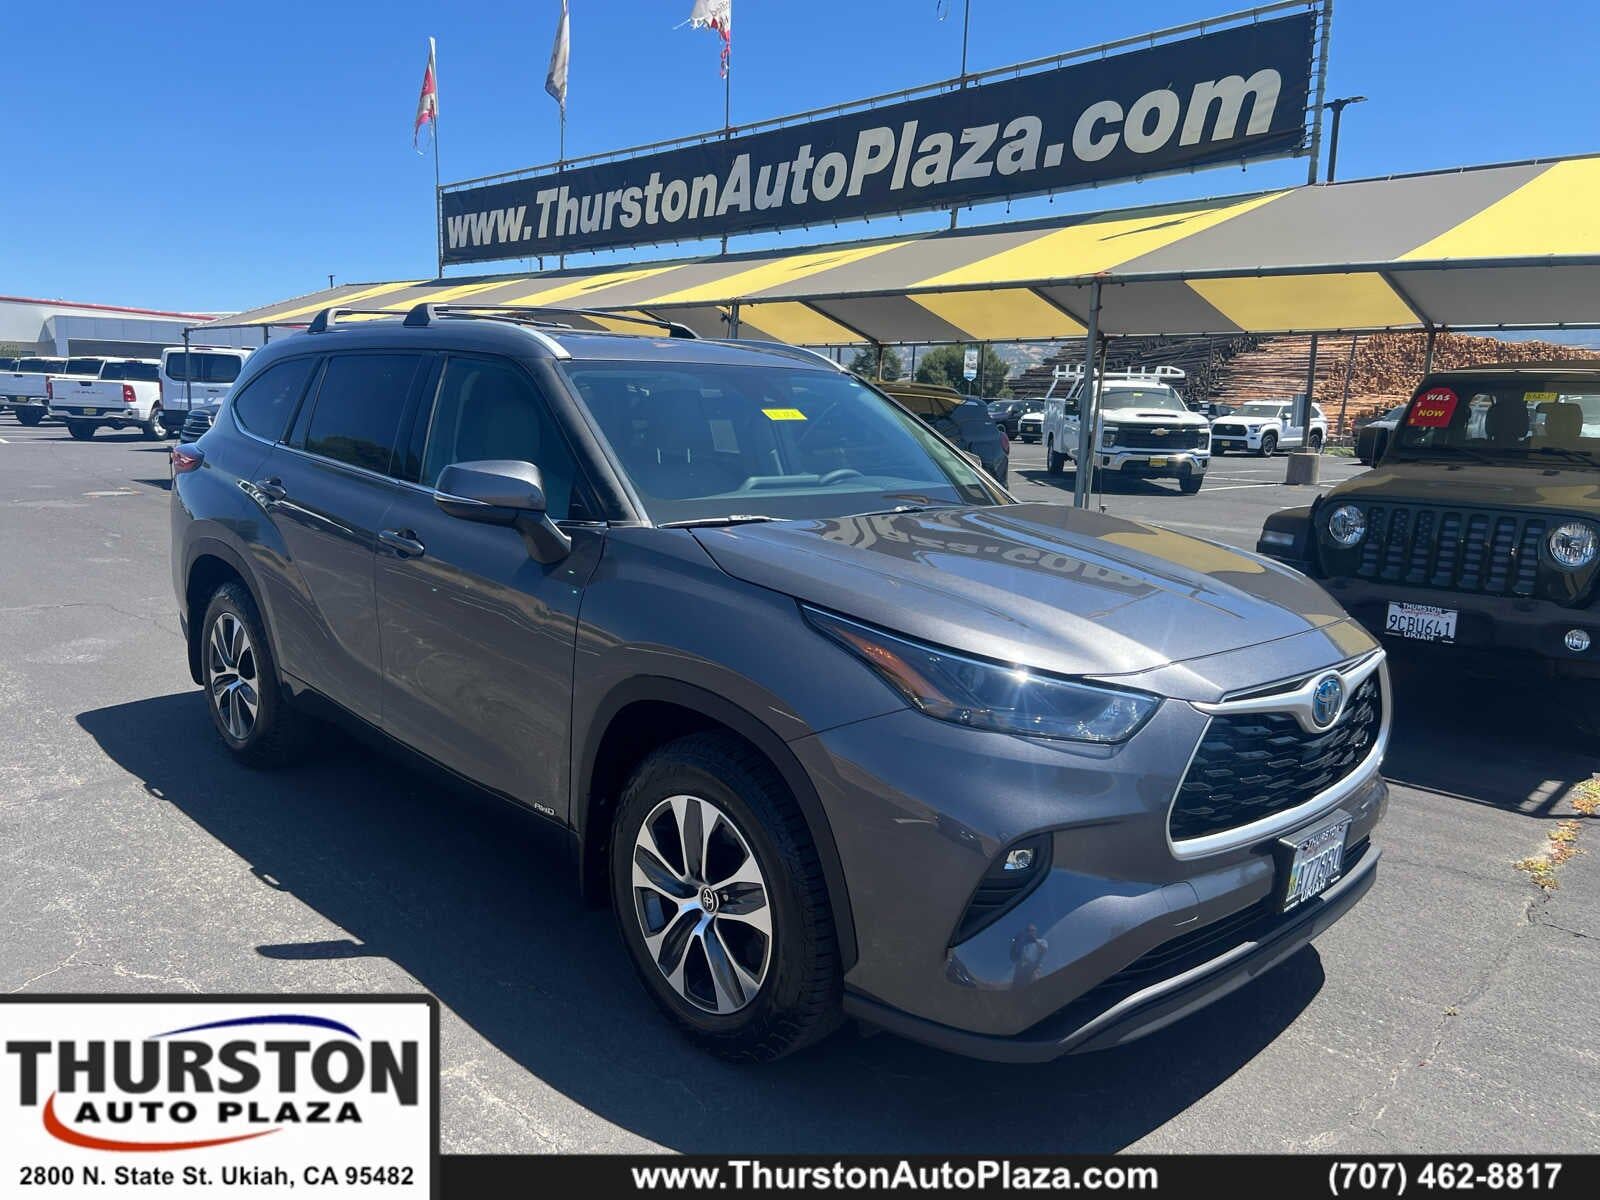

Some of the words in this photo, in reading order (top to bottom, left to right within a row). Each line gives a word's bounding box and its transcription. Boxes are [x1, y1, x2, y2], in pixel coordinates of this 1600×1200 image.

[448, 68, 1282, 248] www.ThurstonAutoPlaza.com
[1427, 393, 1450, 401] WAS
[1418, 409, 1445, 417] NOW
[1389, 614, 1450, 635] 9CBU641
